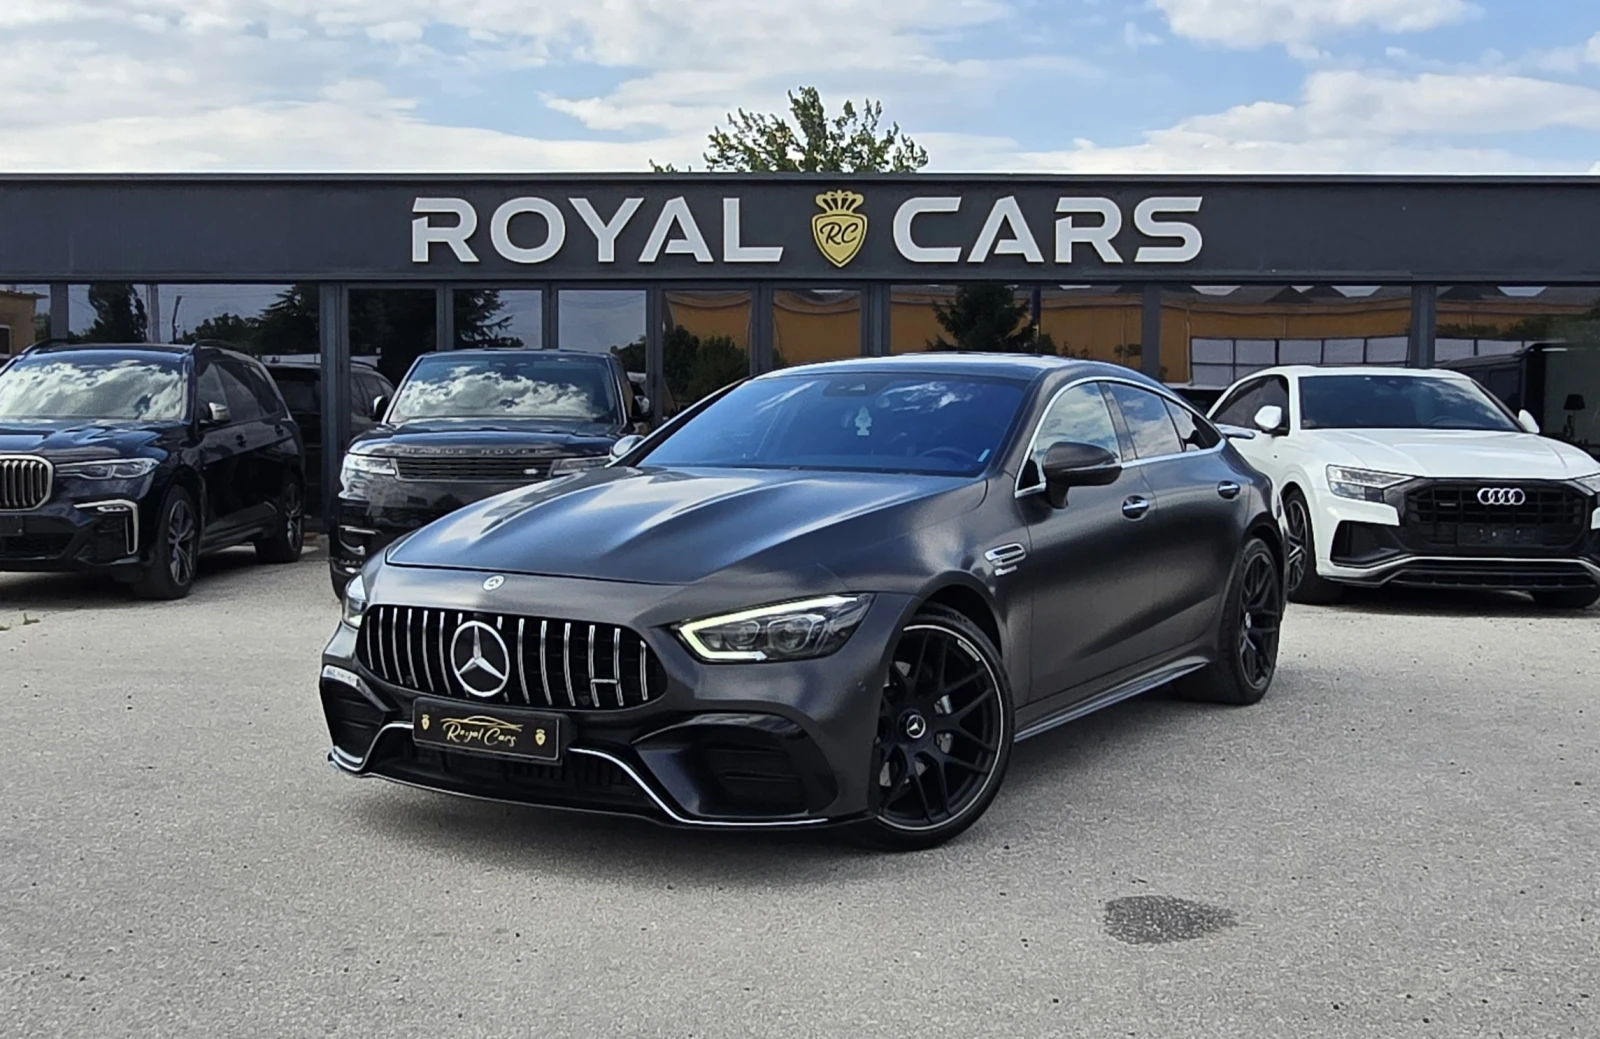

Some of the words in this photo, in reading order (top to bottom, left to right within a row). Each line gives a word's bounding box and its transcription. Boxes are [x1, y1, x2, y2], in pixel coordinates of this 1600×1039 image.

[411, 196, 784, 264] ROYAL
[892, 195, 1203, 264] CARS
[819, 221, 859, 246] RC
[442, 721, 484, 743] Royal
[484, 727, 517, 747] Cars
